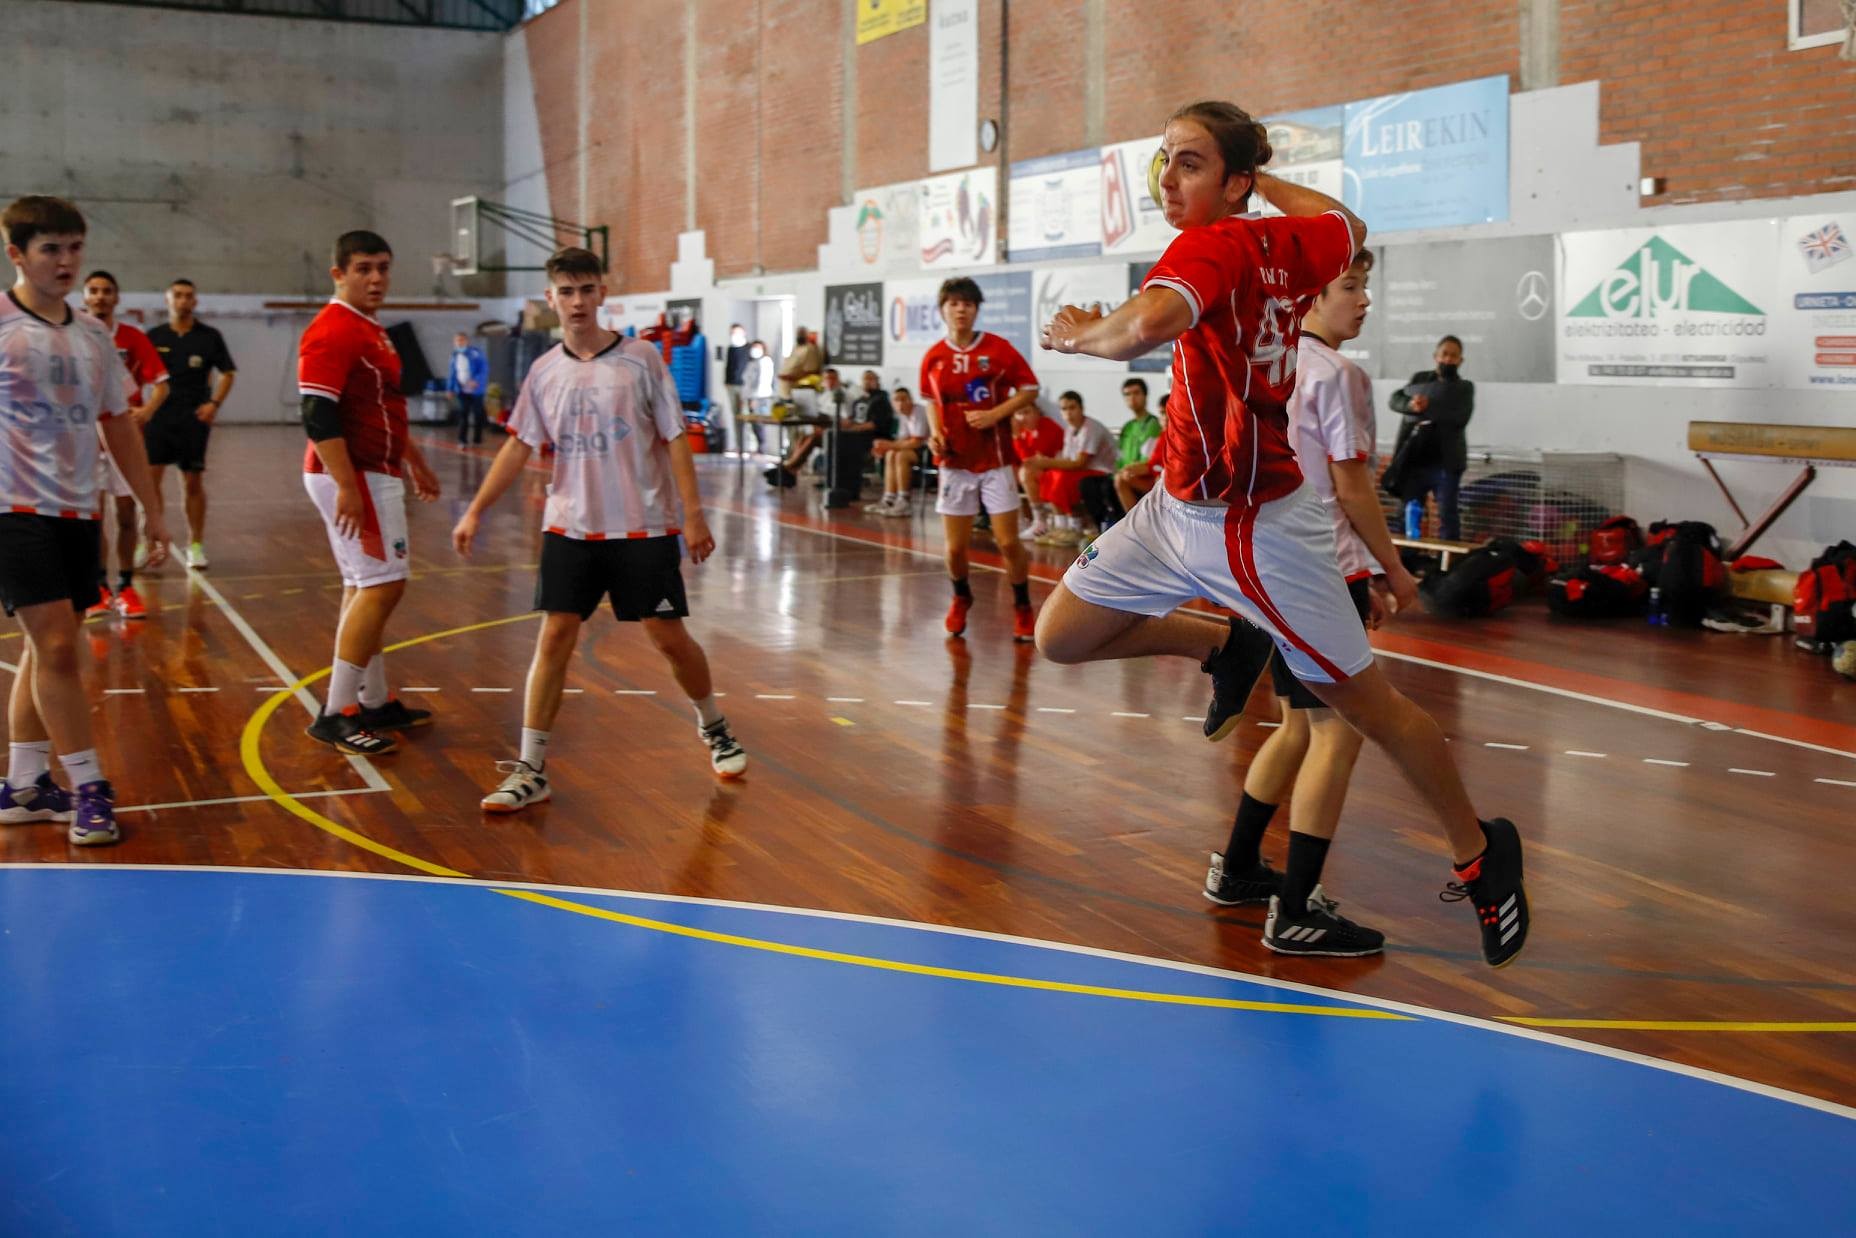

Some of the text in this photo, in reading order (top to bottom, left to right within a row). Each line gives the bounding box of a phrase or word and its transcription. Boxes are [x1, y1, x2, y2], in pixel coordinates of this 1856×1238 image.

[1361, 110, 1490, 157] LEIREKIN
[1600, 247, 1702, 320] elur
[1565, 321, 1659, 337] elektrizitatea
[1673, 317, 1766, 336] electricidad
[952, 353, 970, 374] 51
